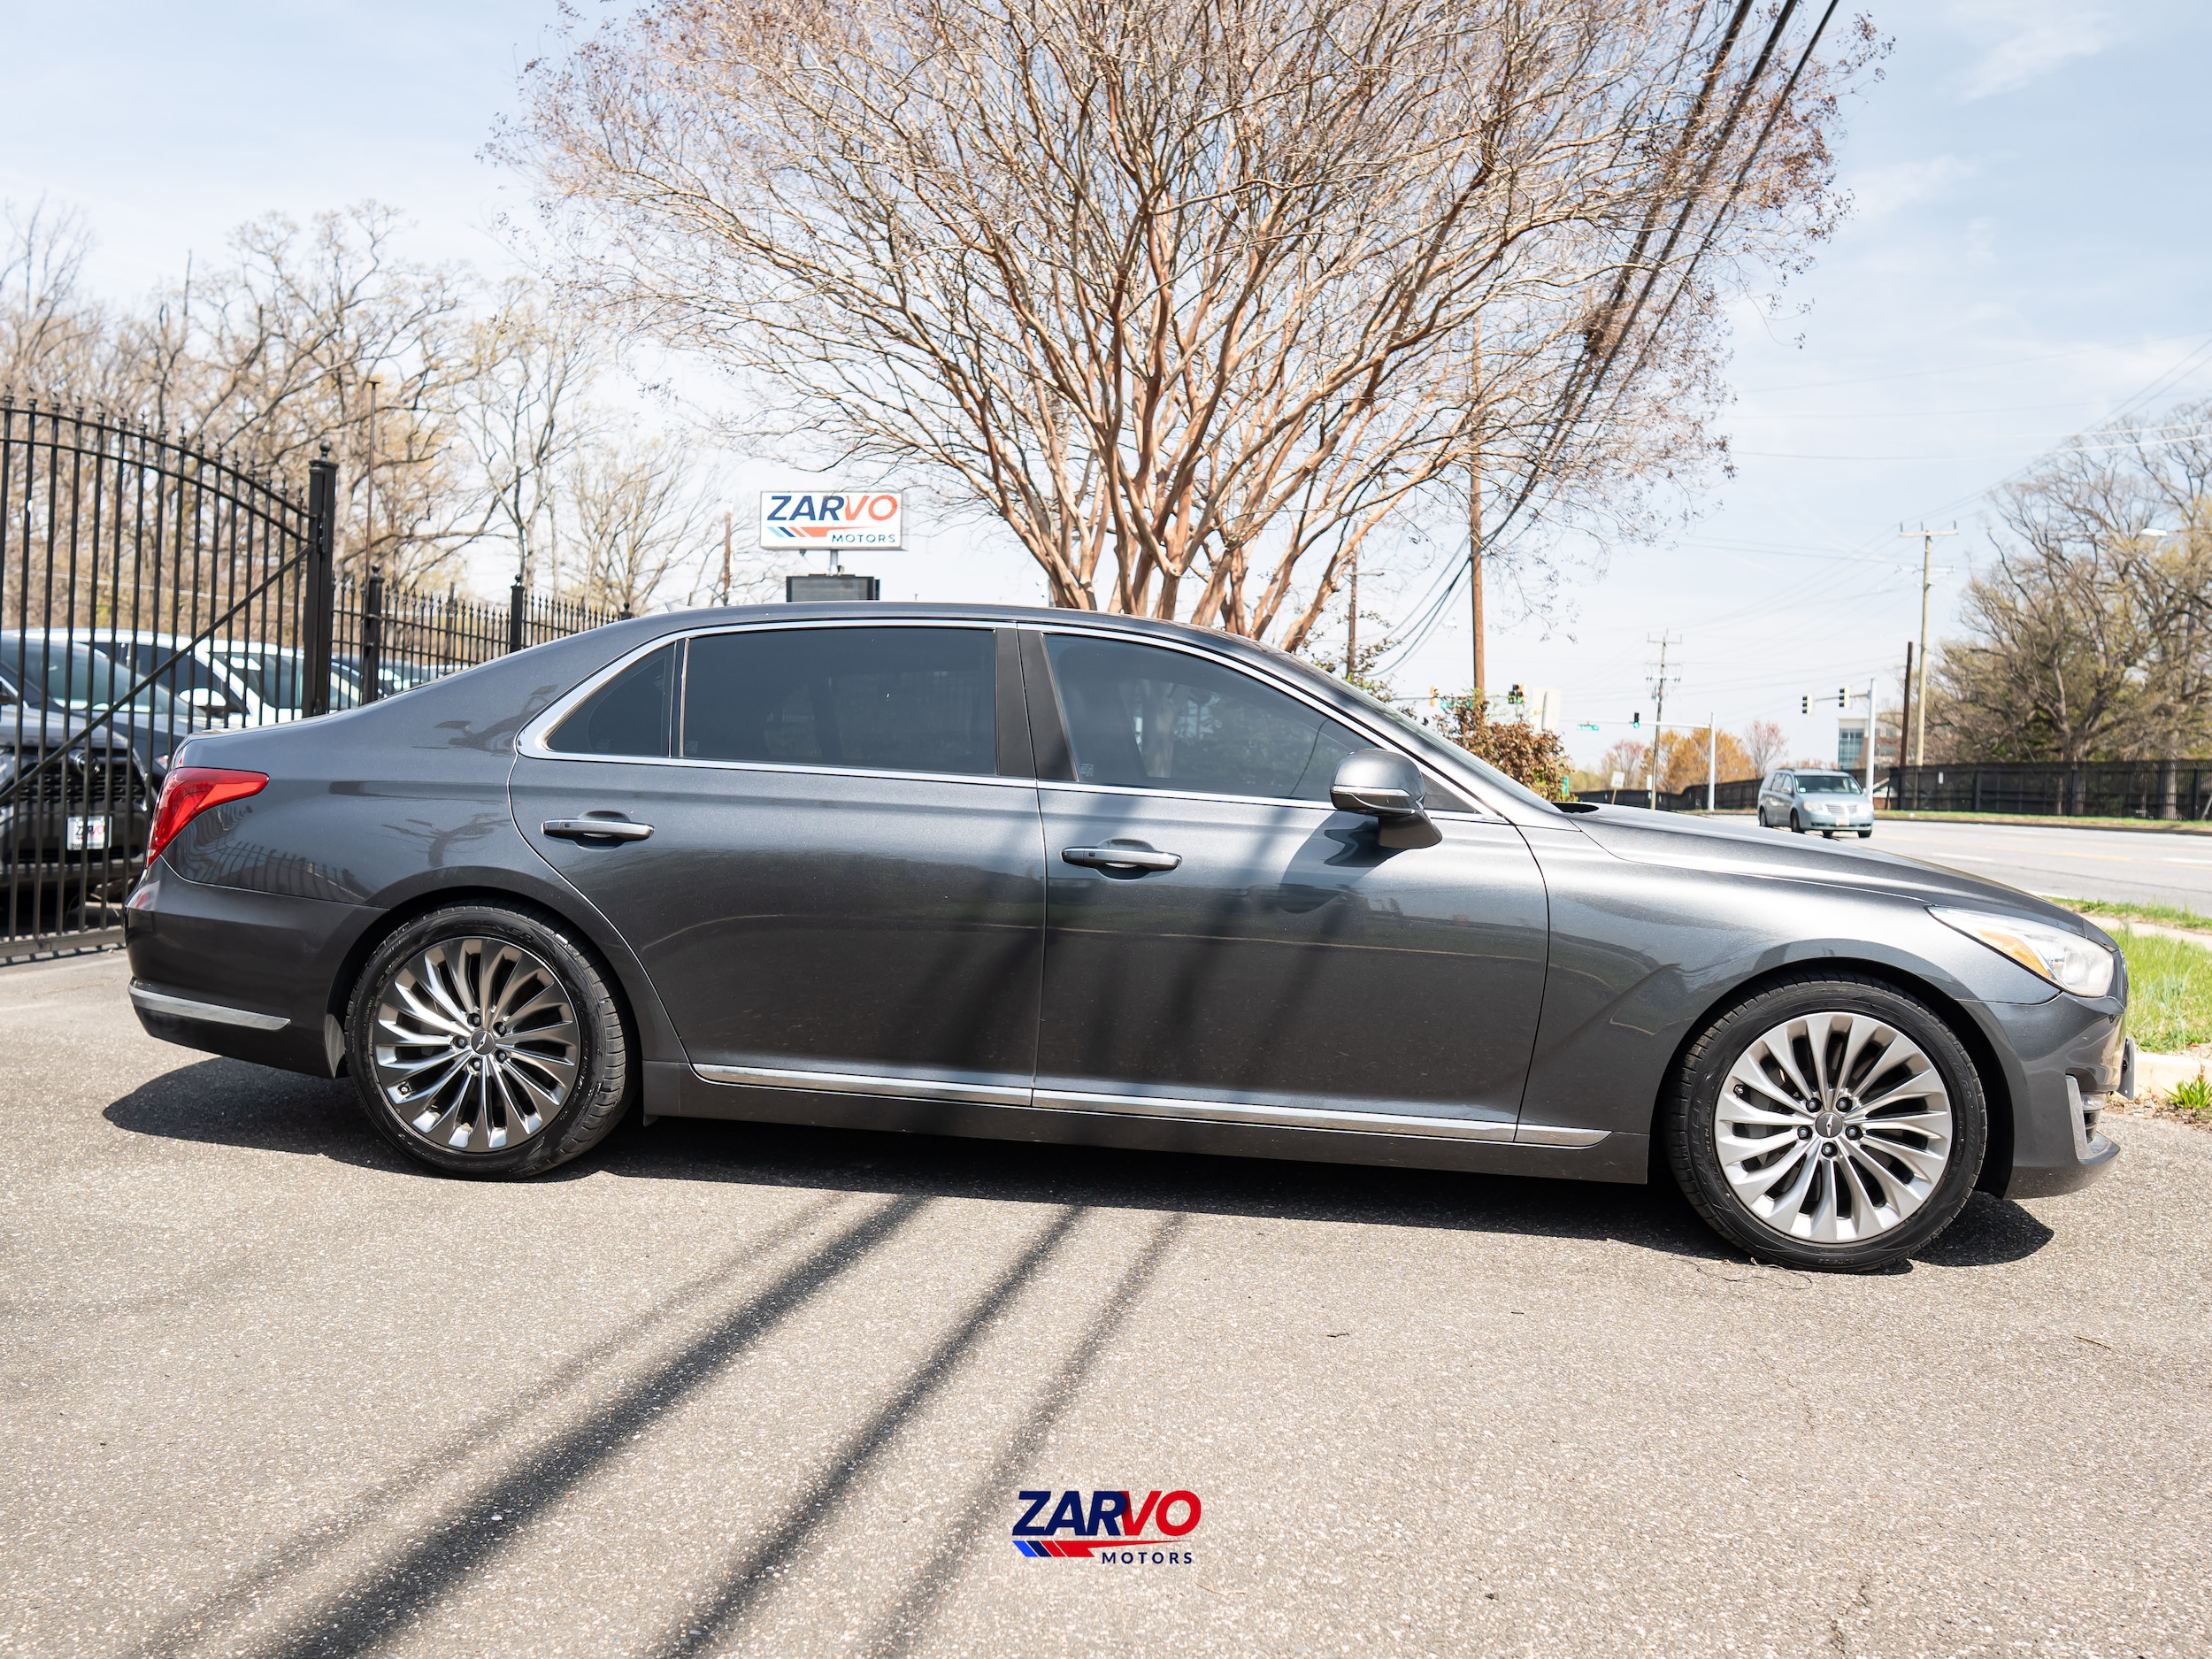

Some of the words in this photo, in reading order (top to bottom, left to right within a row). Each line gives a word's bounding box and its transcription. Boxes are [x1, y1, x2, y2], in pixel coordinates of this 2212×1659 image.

[766, 495, 898, 521] ZARVO
[831, 534, 895, 543] MOTORS
[75, 826, 105, 836] ZRVO
